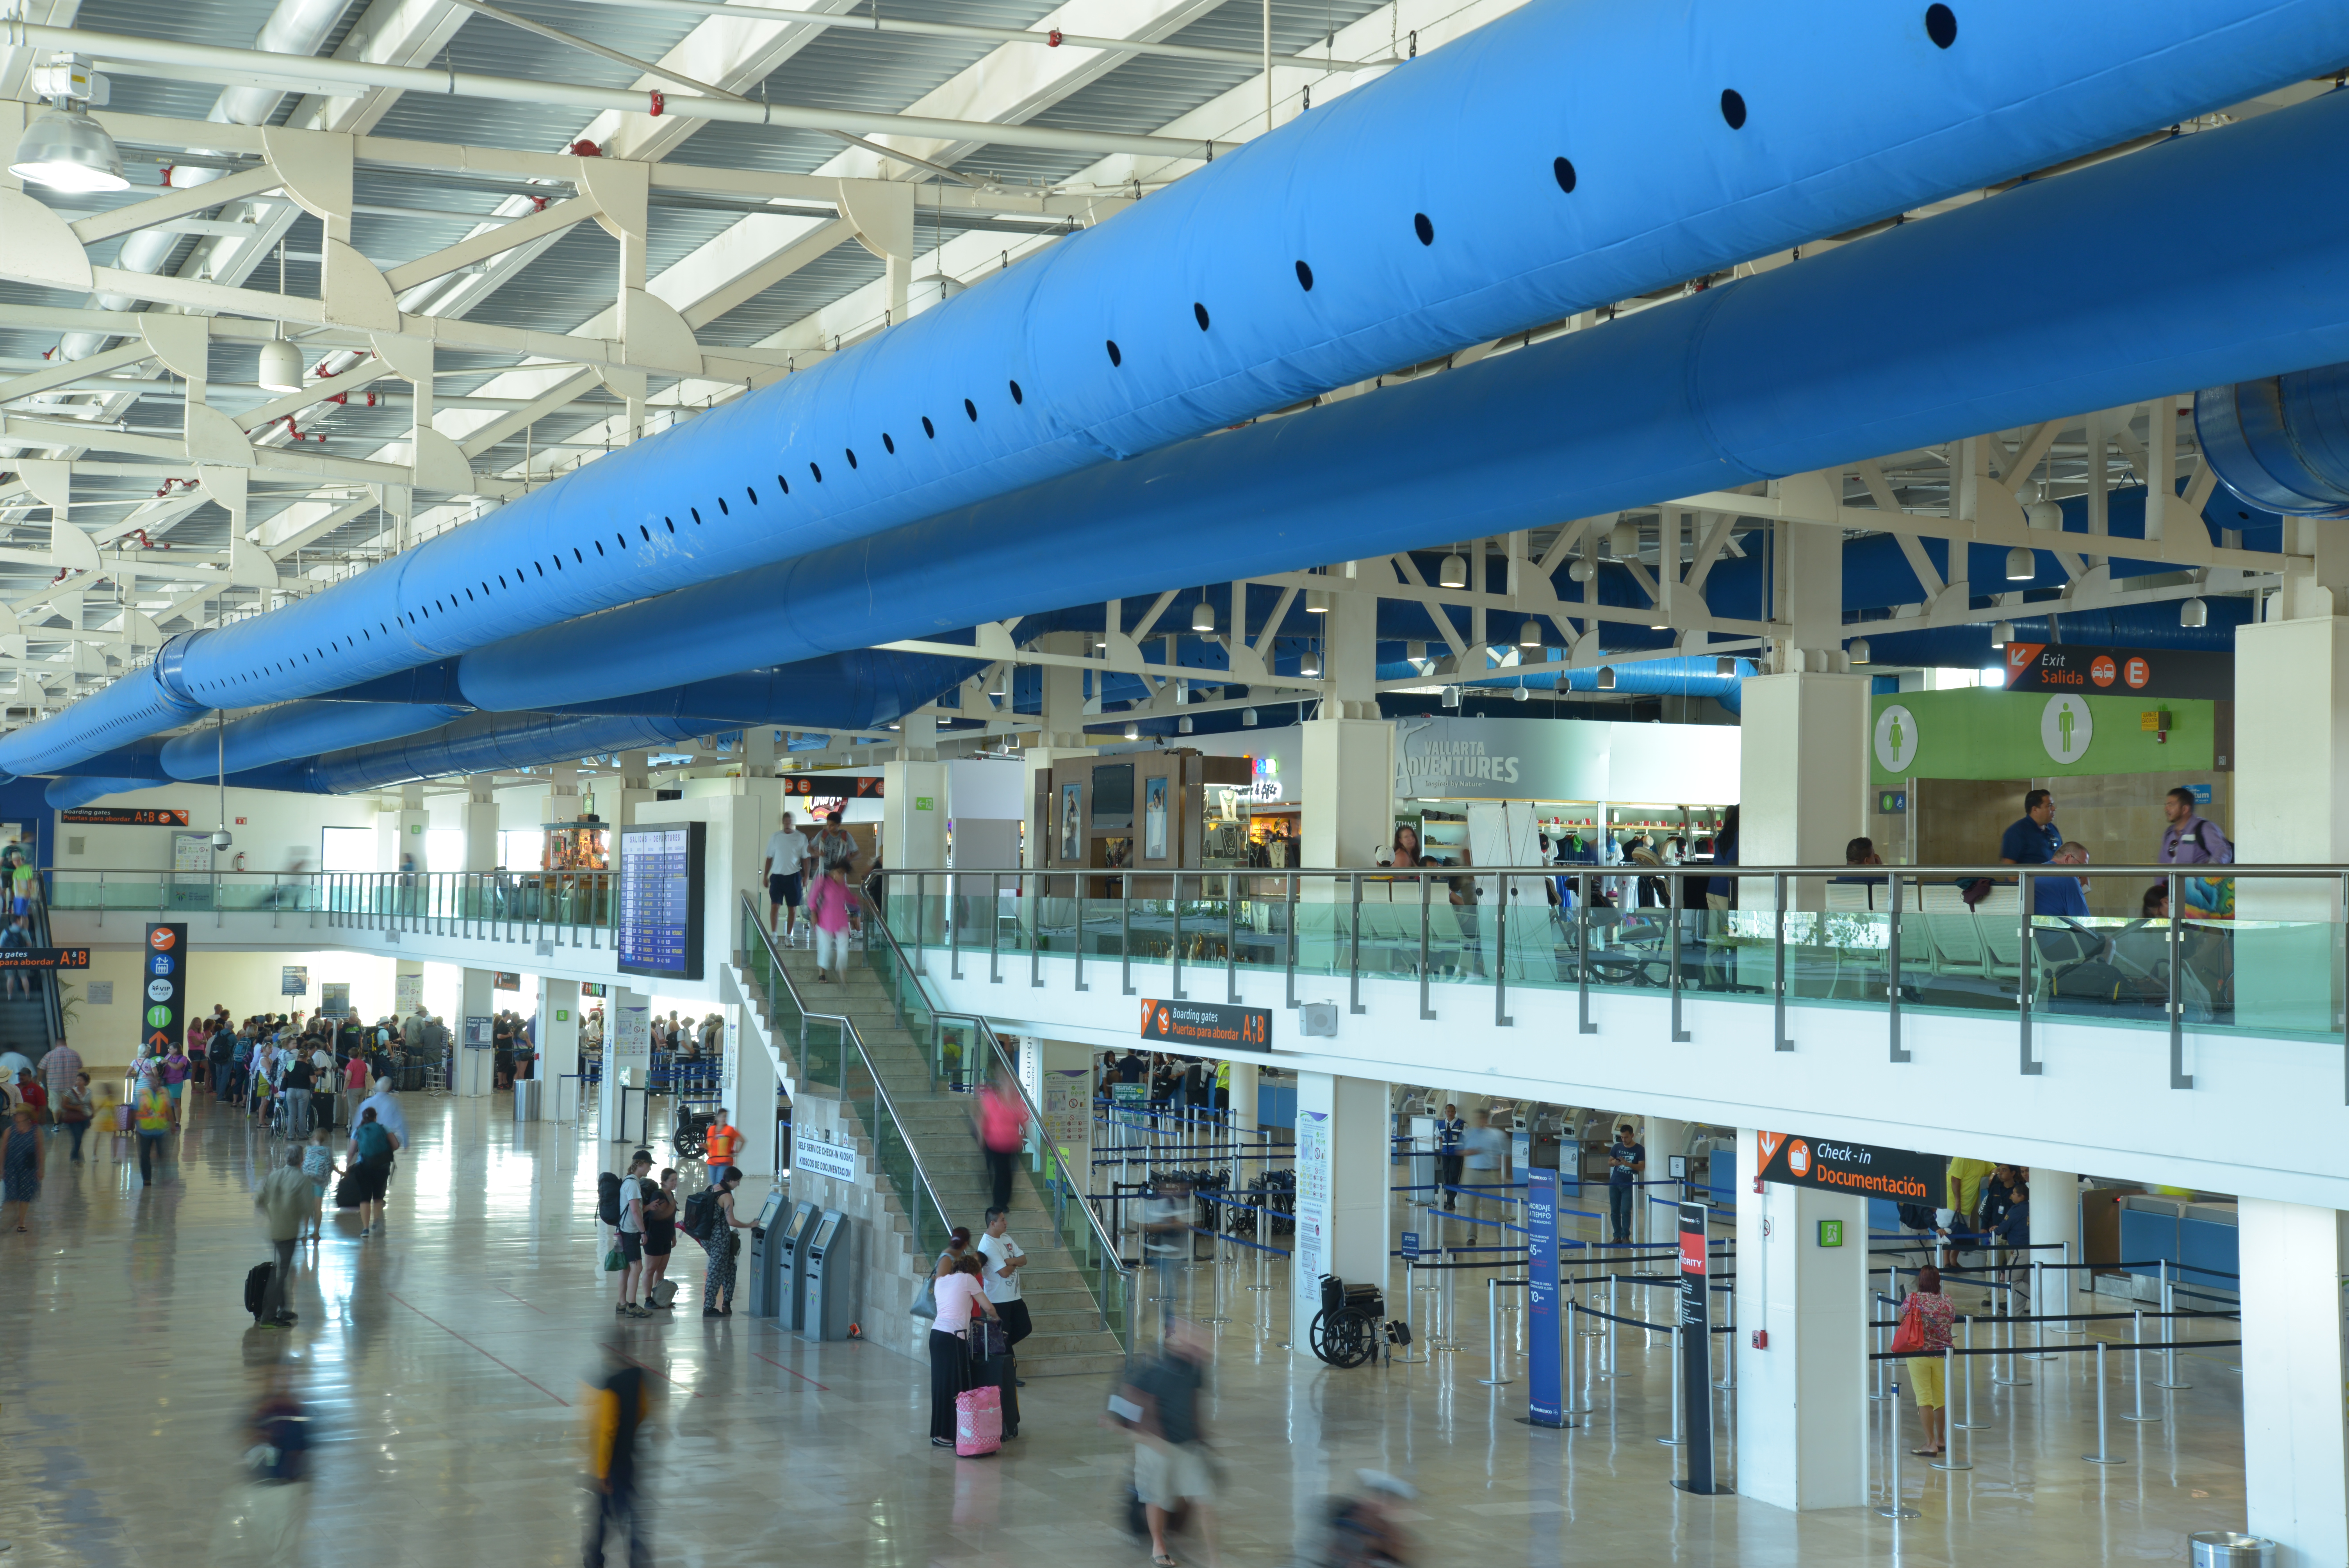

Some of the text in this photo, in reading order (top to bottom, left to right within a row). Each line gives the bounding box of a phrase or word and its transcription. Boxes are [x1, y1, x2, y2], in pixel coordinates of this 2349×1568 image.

[2042, 654, 2066, 666] Exit
[2042, 670, 2083, 684] Salida
[2130, 662, 2143, 683] E
[1424, 741, 1485, 755] VALLARTA
[2219, 756, 2225, 765] 61
[1395, 756, 1518, 788] ADVENTURES
[801, 782, 807, 791] E
[1261, 783, 1277, 799] Gifts
[135, 811, 142, 821] A
[149, 812, 155, 821] B
[654, 834, 680, 842] DEPARTURES
[60, 951, 70, 964] A
[79, 951, 86, 964] B
[1173, 1008, 1218, 1024] Boarding gates
[1173, 1022, 1239, 1041] Puertas para abordar
[1243, 1014, 1264, 1042] A & B
[1253, 1032, 1256, 1044] y
[807, 1143, 821, 1154] SERVICE
[822, 1147, 839, 1159] CHECK-IN
[839, 1151, 854, 1163] KIOSKS
[1818, 1143, 1871, 1164] Check-in
[799, 1156, 851, 1178] KIOSCOS DE DOCUMENTACION
[1818, 1164, 1926, 1197] Documentación
[1529, 1203, 1551, 1212] ABORDAJE
[1530, 1244, 1537, 1256] 45
[1681, 1256, 1702, 1267] RIORITY
[1531, 1290, 1538, 1303] 10
